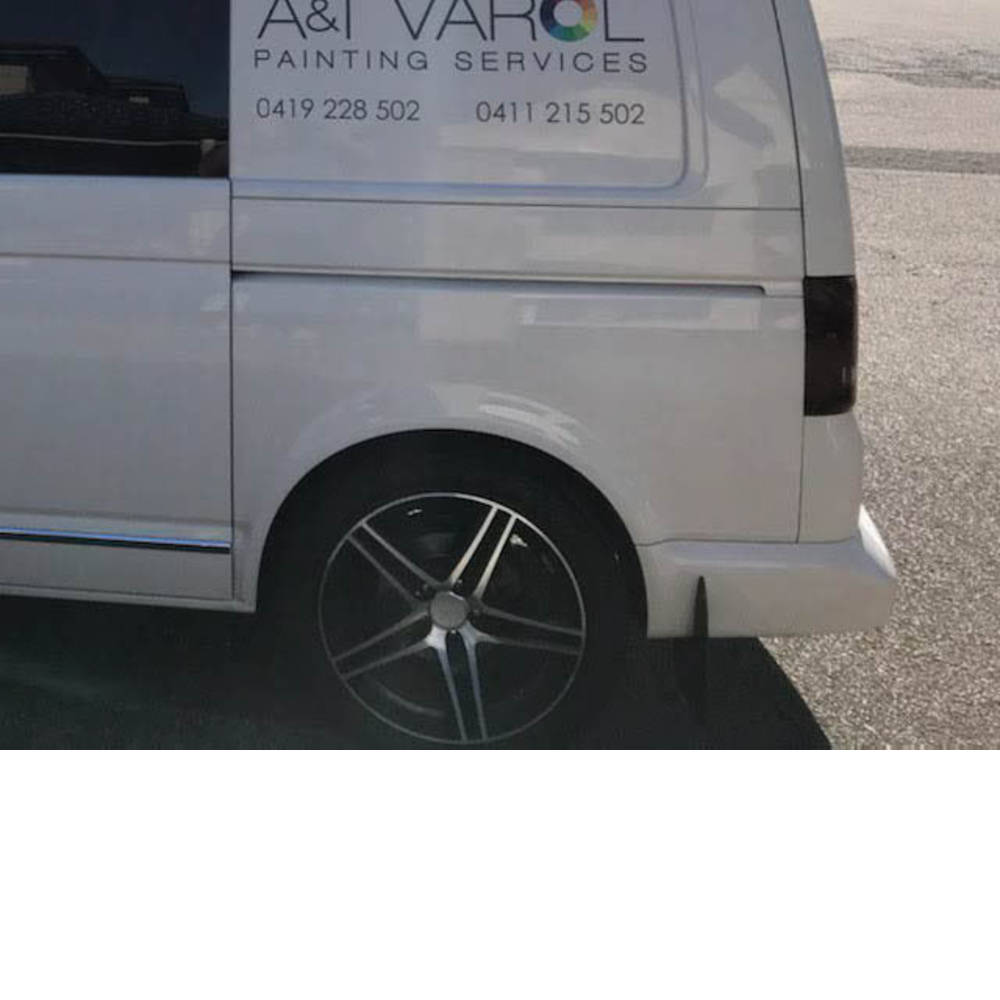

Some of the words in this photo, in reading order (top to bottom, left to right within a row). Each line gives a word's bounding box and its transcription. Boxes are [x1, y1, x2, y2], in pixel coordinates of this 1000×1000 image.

[254, 49, 428, 71] PAINTING
[455, 50, 648, 74] SERVICES
[256, 99, 313, 120] 0419
[323, 99, 368, 121] 228
[375, 99, 421, 122] 502
[476, 101, 534, 124] 0411
[547, 101, 591, 125] 215
[600, 102, 646, 126] 502
